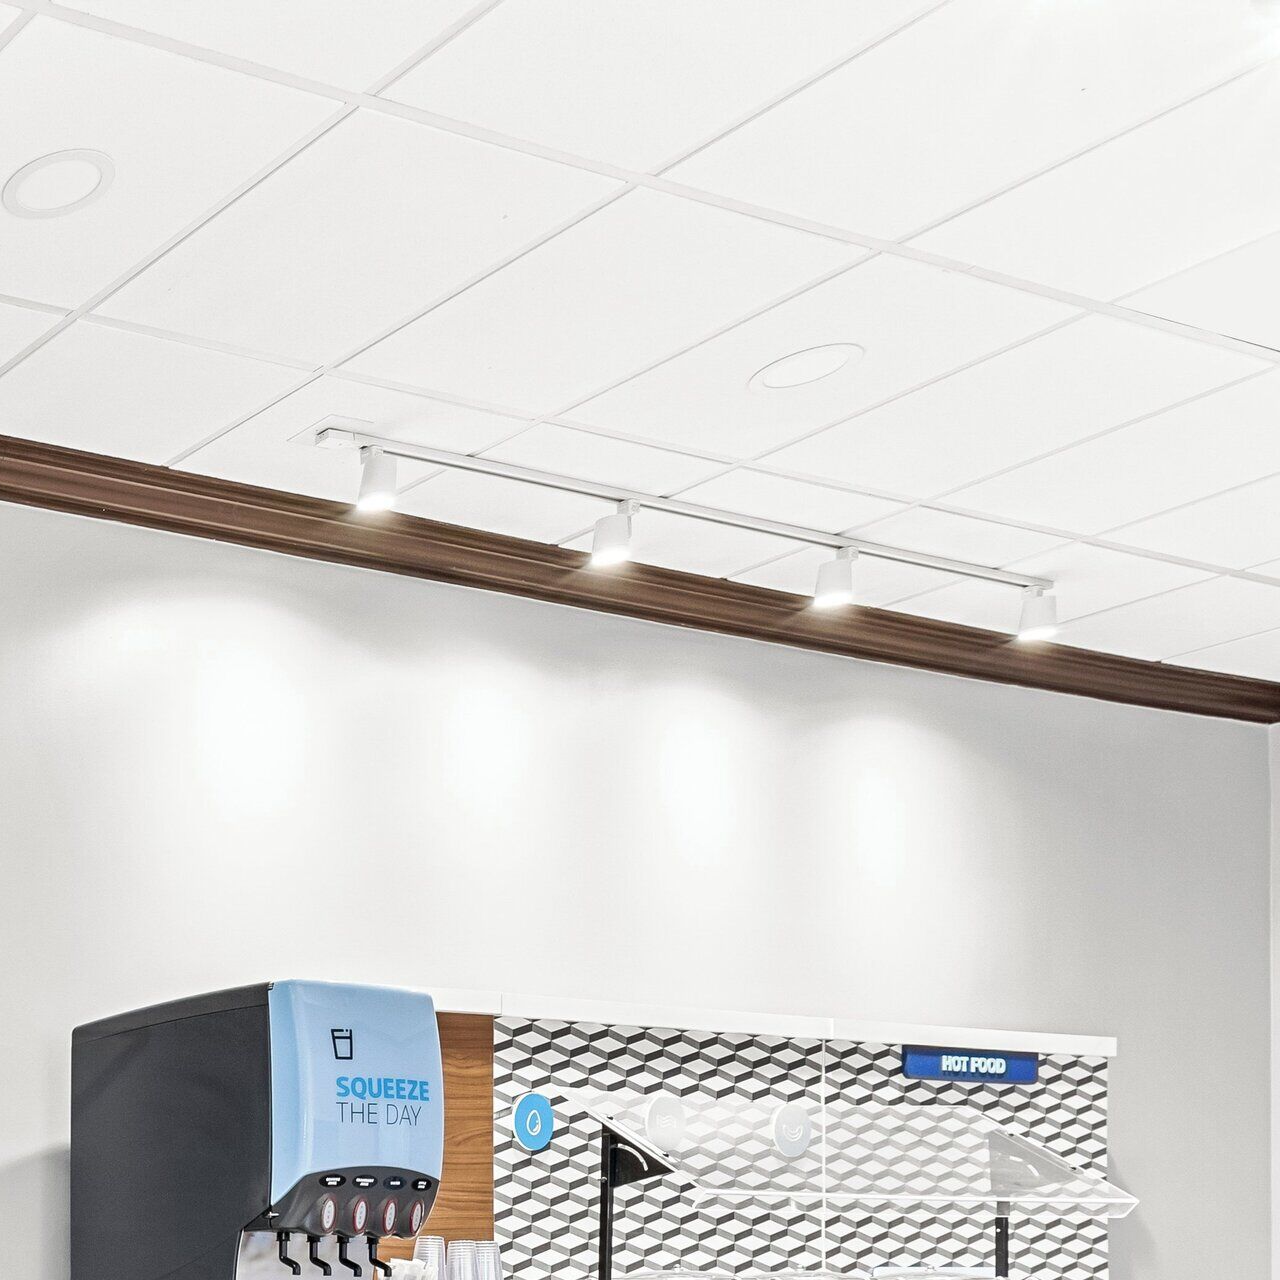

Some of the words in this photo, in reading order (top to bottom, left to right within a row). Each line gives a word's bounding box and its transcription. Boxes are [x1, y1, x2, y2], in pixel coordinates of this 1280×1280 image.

[941, 1055, 969, 1072] HOT
[970, 1057, 1006, 1074] FOOD
[335, 1076, 430, 1101] SQUEEZE
[336, 1101, 378, 1125] THE
[386, 1103, 422, 1126] DAY
